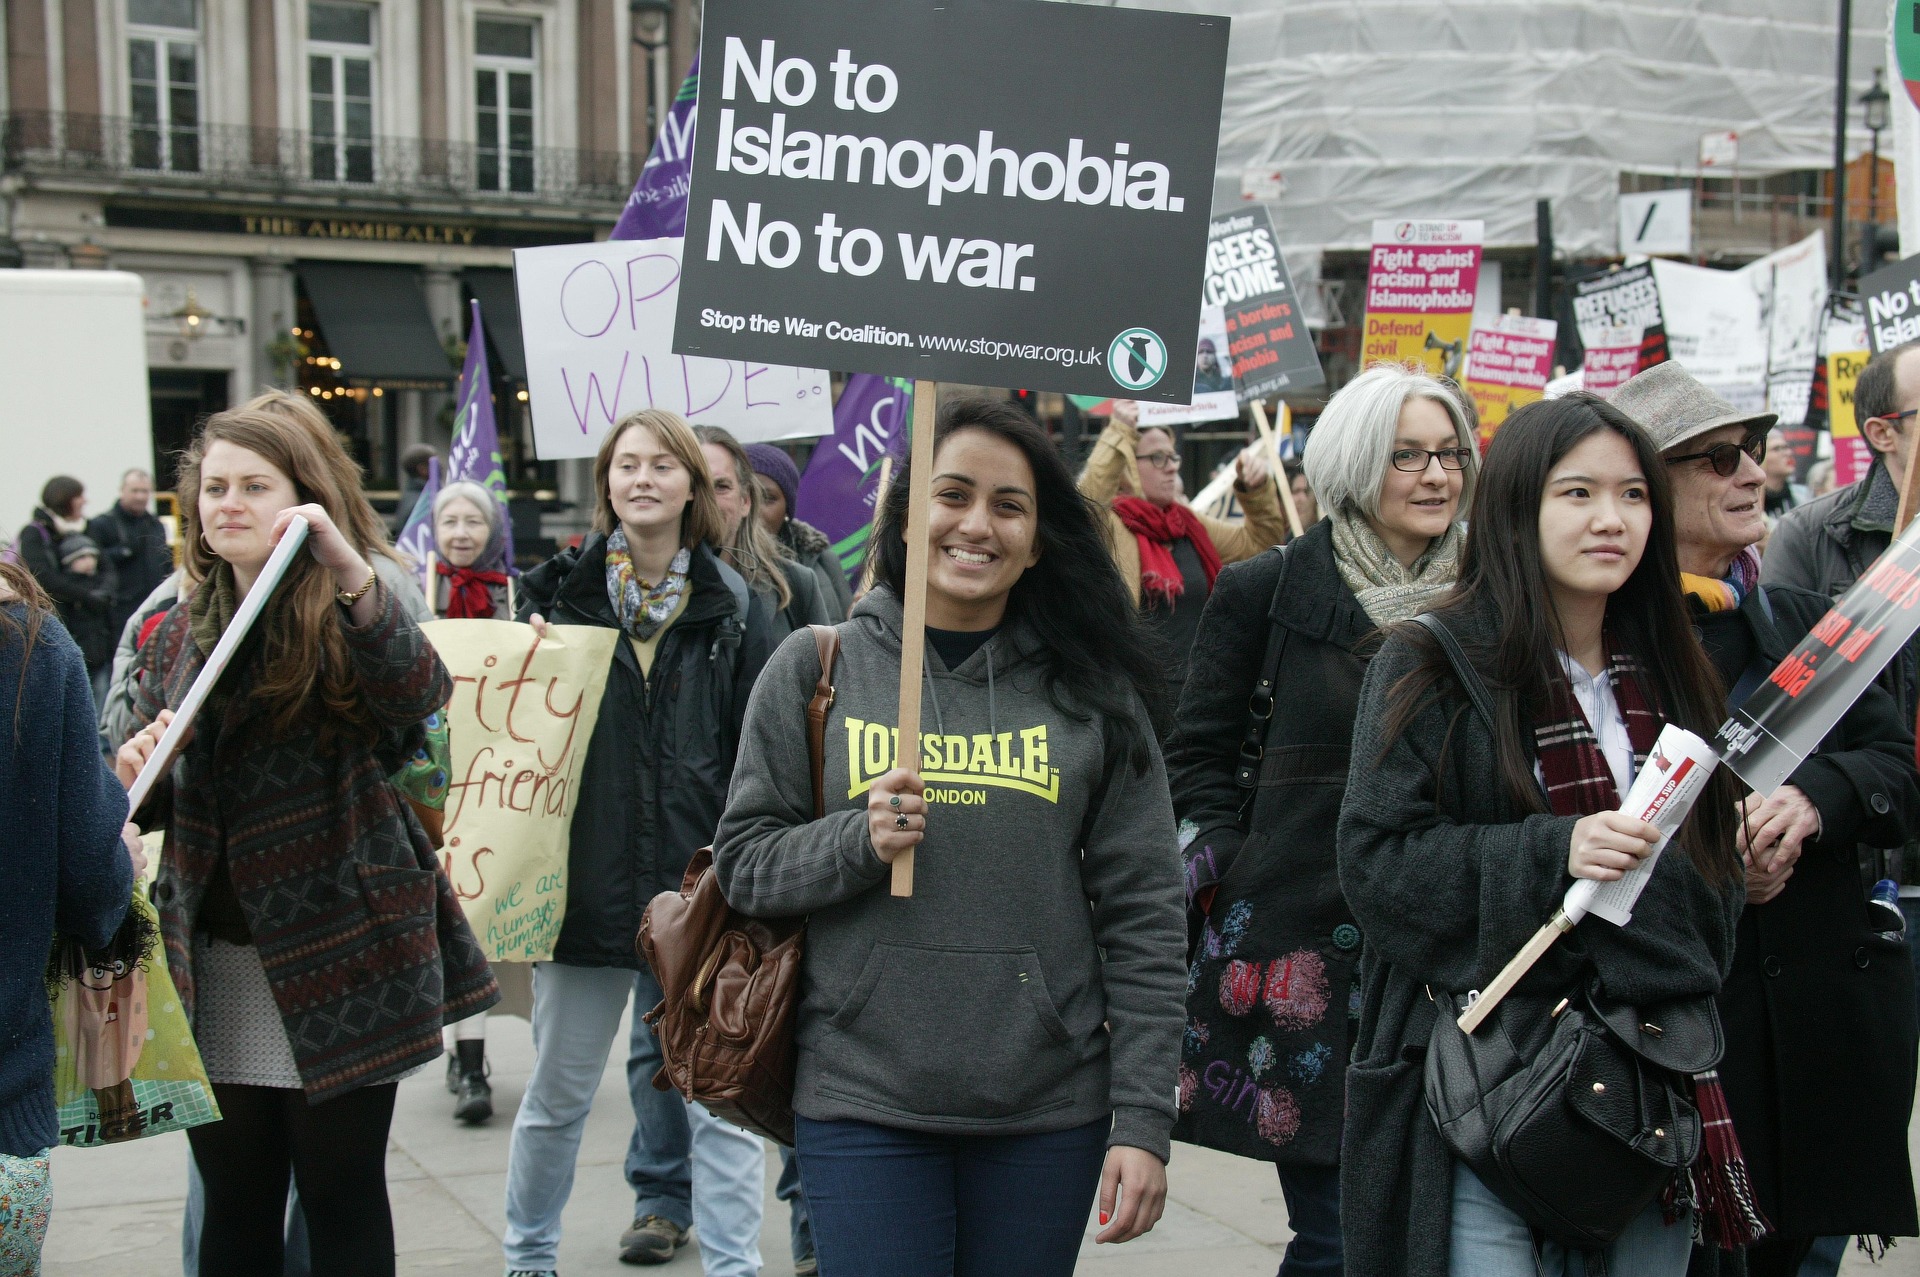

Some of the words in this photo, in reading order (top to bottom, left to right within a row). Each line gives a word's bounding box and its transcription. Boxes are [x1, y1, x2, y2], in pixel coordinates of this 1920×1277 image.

[722, 36, 817, 106] No
[830, 49, 899, 113] to
[715, 108, 1185, 213] Islamophobia.
[242, 216, 299, 236] THE
[307, 219, 476, 245] ADMIRALTY
[706, 199, 802, 268] No
[815, 213, 883, 277] to
[898, 232, 1036, 292] war.
[1372, 248, 1414, 271] Fight
[1417, 249, 1475, 272] against
[1371, 270, 1426, 288] racism
[1429, 270, 1460, 288] and
[1237, 303, 1291, 328] borders
[1369, 288, 1474, 312] Islamophobia
[1868, 291, 1909, 325] No
[700, 308, 746, 334] Stop
[749, 314, 780, 334] the
[784, 317, 822, 339] War
[825, 321, 914, 347] Coalition.
[918, 334, 1102, 367] www.stopwar.org.uk
[1269, 321, 1294, 343] and
[1368, 318, 1424, 336] Defend
[1366, 340, 1397, 356] civil
[1836, 626, 1886, 663] and
[922, 787, 986, 805] ONDON
[1642, 805, 1657, 823] Join
[1653, 794, 1666, 808] the
[1662, 779, 1676, 797] SWP
[495, 881, 524, 915] we
[536, 867, 563, 895] are
[1231, 959, 1292, 1006] Wild
[60, 1101, 174, 1145] TIGER
